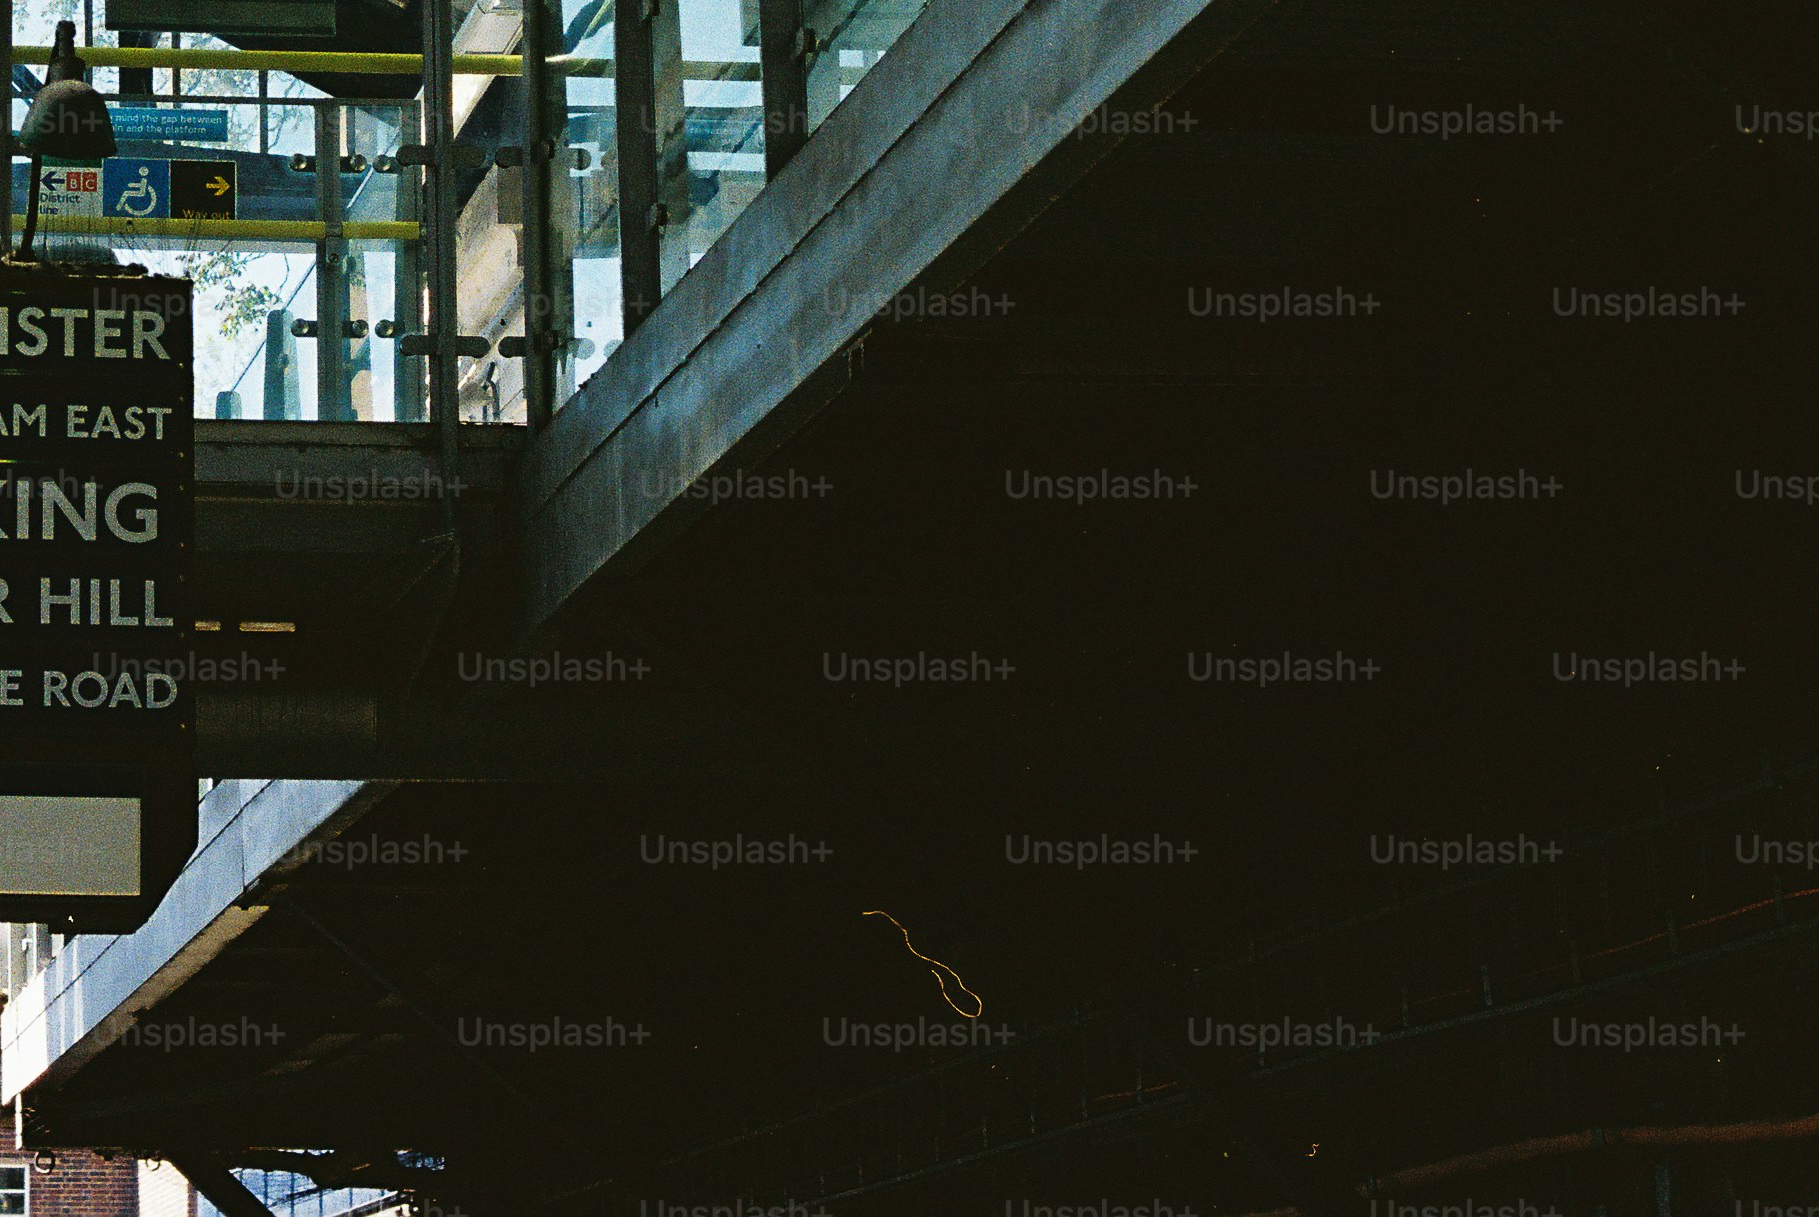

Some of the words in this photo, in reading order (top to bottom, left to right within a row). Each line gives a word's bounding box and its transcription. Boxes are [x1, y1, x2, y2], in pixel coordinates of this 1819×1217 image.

[115, 114, 139, 124] mind
[142, 115, 158, 124] the
[161, 116, 177, 126] gap
[180, 116, 223, 125] between
[146, 125, 162, 133] the
[165, 125, 207, 134] platform
[39, 192, 81, 204] District
[39, 205, 59, 215] line
[182, 209, 209, 220] Way
[210, 211, 232, 220] out
[66, 405, 173, 441] EAST
[40, 577, 175, 629] HILL
[43, 670, 179, 710] ROAD
